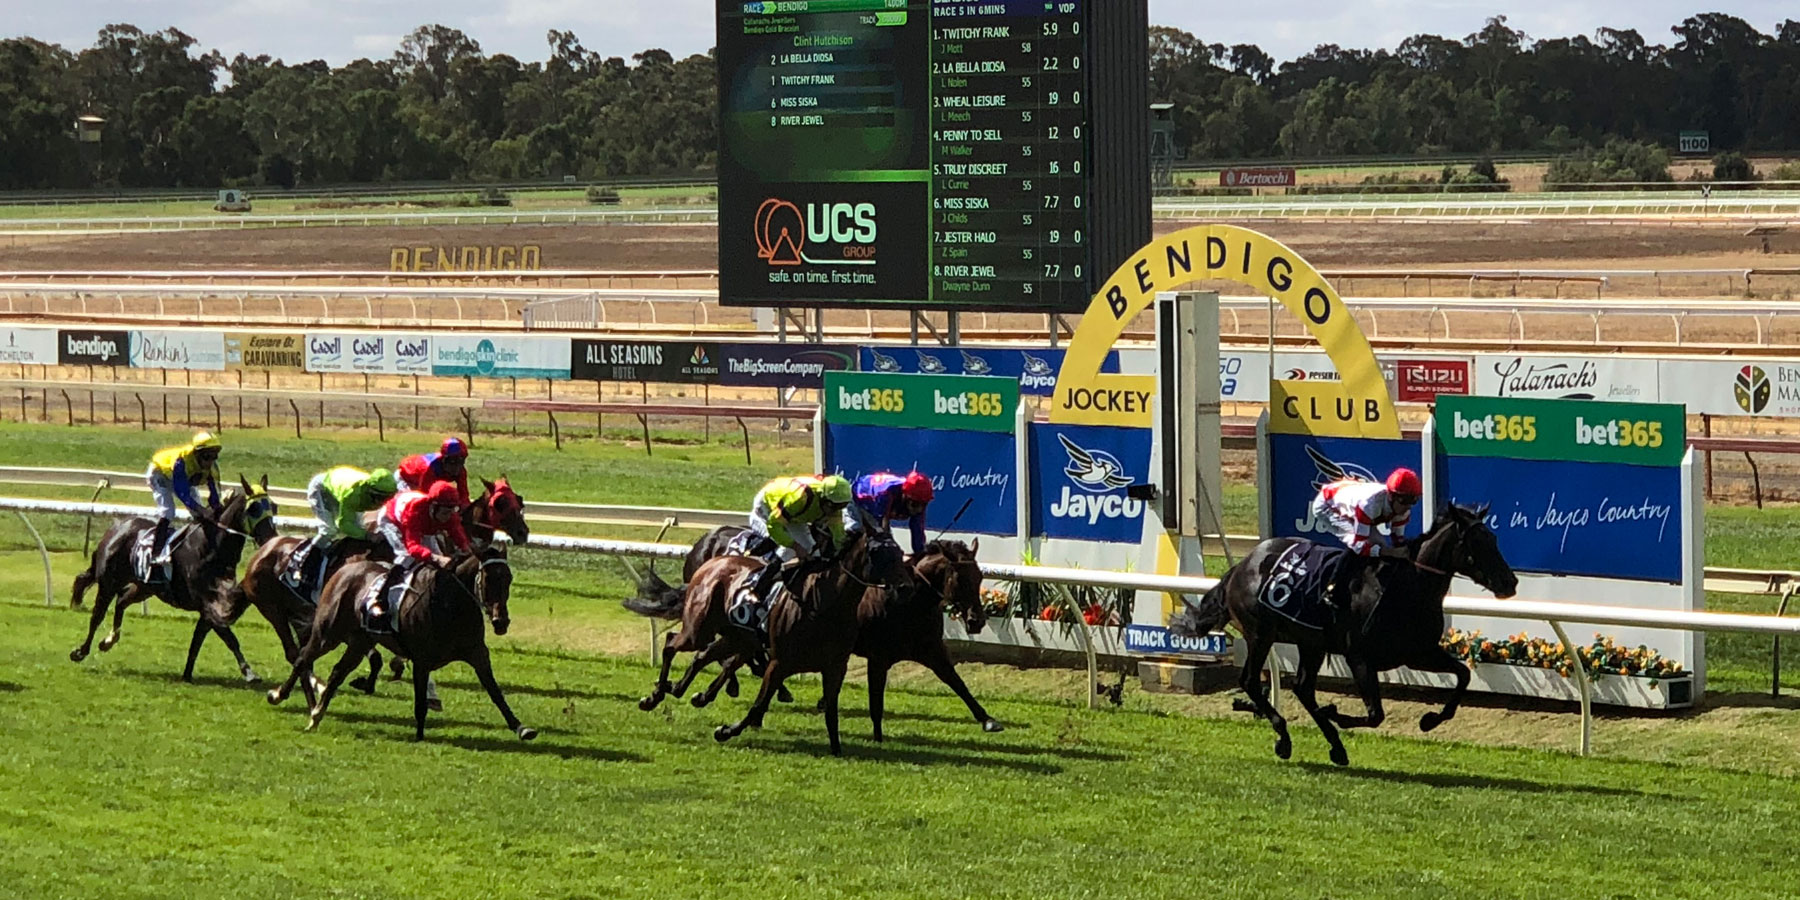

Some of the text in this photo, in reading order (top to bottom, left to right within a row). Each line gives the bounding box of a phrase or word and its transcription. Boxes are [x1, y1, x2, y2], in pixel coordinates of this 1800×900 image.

[743, 4, 761, 13] RACE
[778, 2, 808, 11] BENDIGO
[934, 5, 1006, 17] RACE 5 IN 6MINS
[1058, 3, 1075, 13] VOP
[860, 16, 876, 24] TRACK
[933, 22, 1080, 40] 1. TWITCHY FRANK 5.9 0
[794, 35, 853, 47] Clint Hutchison
[1021, 43, 1032, 53] 58
[771, 53, 834, 65] 2 LA BELLA DIOSA
[933, 56, 1080, 74] 2. LA BELLA DIOSA 2.2 0
[781, 76, 810, 86] TWITCHY
[811, 75, 835, 85] FRANK
[1021, 77, 1032, 87] 55
[771, 97, 818, 108] 6 MISS SISKA
[933, 91, 1080, 107] 3. WHEAL LEISURE 19 0
[771, 115, 824, 127] 8 RIVER JEWEL
[1021, 112, 1032, 122] 55
[933, 126, 1080, 142] 4. PENNY TO SELL 12 0
[1022, 146, 1032, 156] 55
[1680, 138, 1708, 149] 1100
[934, 161, 1081, 175] 5. TRULY DISCREET 16 0
[1022, 180, 1032, 190] 55
[1239, 171, 1289, 185] Bertocchi
[934, 196, 1081, 209] 6. MISS SISKA 7.7 0
[807, 203, 877, 243] UCS
[1022, 215, 1032, 225] 55
[934, 230, 1081, 243] 7. JESTER HALO 19 0
[390, 245, 542, 272] BENDIGO
[843, 246, 876, 258] GROUP
[1023, 249, 1032, 259] 55
[769, 269, 790, 283] safe.
[793, 272, 805, 283] on
[807, 270, 829, 283] time.
[852, 271, 876, 284] time.
[934, 265, 1081, 278] 8. RIVER JEWEL 7.7 0
[943, 281, 1033, 293] Dwayne Dunn 55
[1105, 236, 1331, 324] BENDIGO
[67, 335, 118, 361] bendigo
[143, 336, 190, 363] Rankin's
[250, 336, 281, 348] Explore
[311, 337, 341, 354] Cadell
[353, 338, 384, 355] Cadell
[396, 339, 428, 357] Cadell
[244, 350, 302, 367] CARAVANNING
[586, 344, 663, 366] ALL SEASONS
[612, 366, 637, 379] HOTEL
[728, 357, 825, 378] TheBigScreenCompany
[1020, 372, 1056, 389] Jayco
[1406, 368, 1463, 383] ISUZU
[838, 385, 904, 412] bet365
[934, 389, 1002, 416] bet365
[1063, 388, 1380, 422] JOCKEY CLUB
[1454, 411, 1536, 441] bet365
[1576, 417, 1662, 447] bet365
[951, 466, 1009, 507] Country
[1050, 486, 1142, 525] Jayco
[1510, 501, 1529, 528] in
[1536, 492, 1589, 553] Jayco
[1597, 497, 1671, 543] Country
[1128, 629, 1221, 652] TRACK GOOD 3
